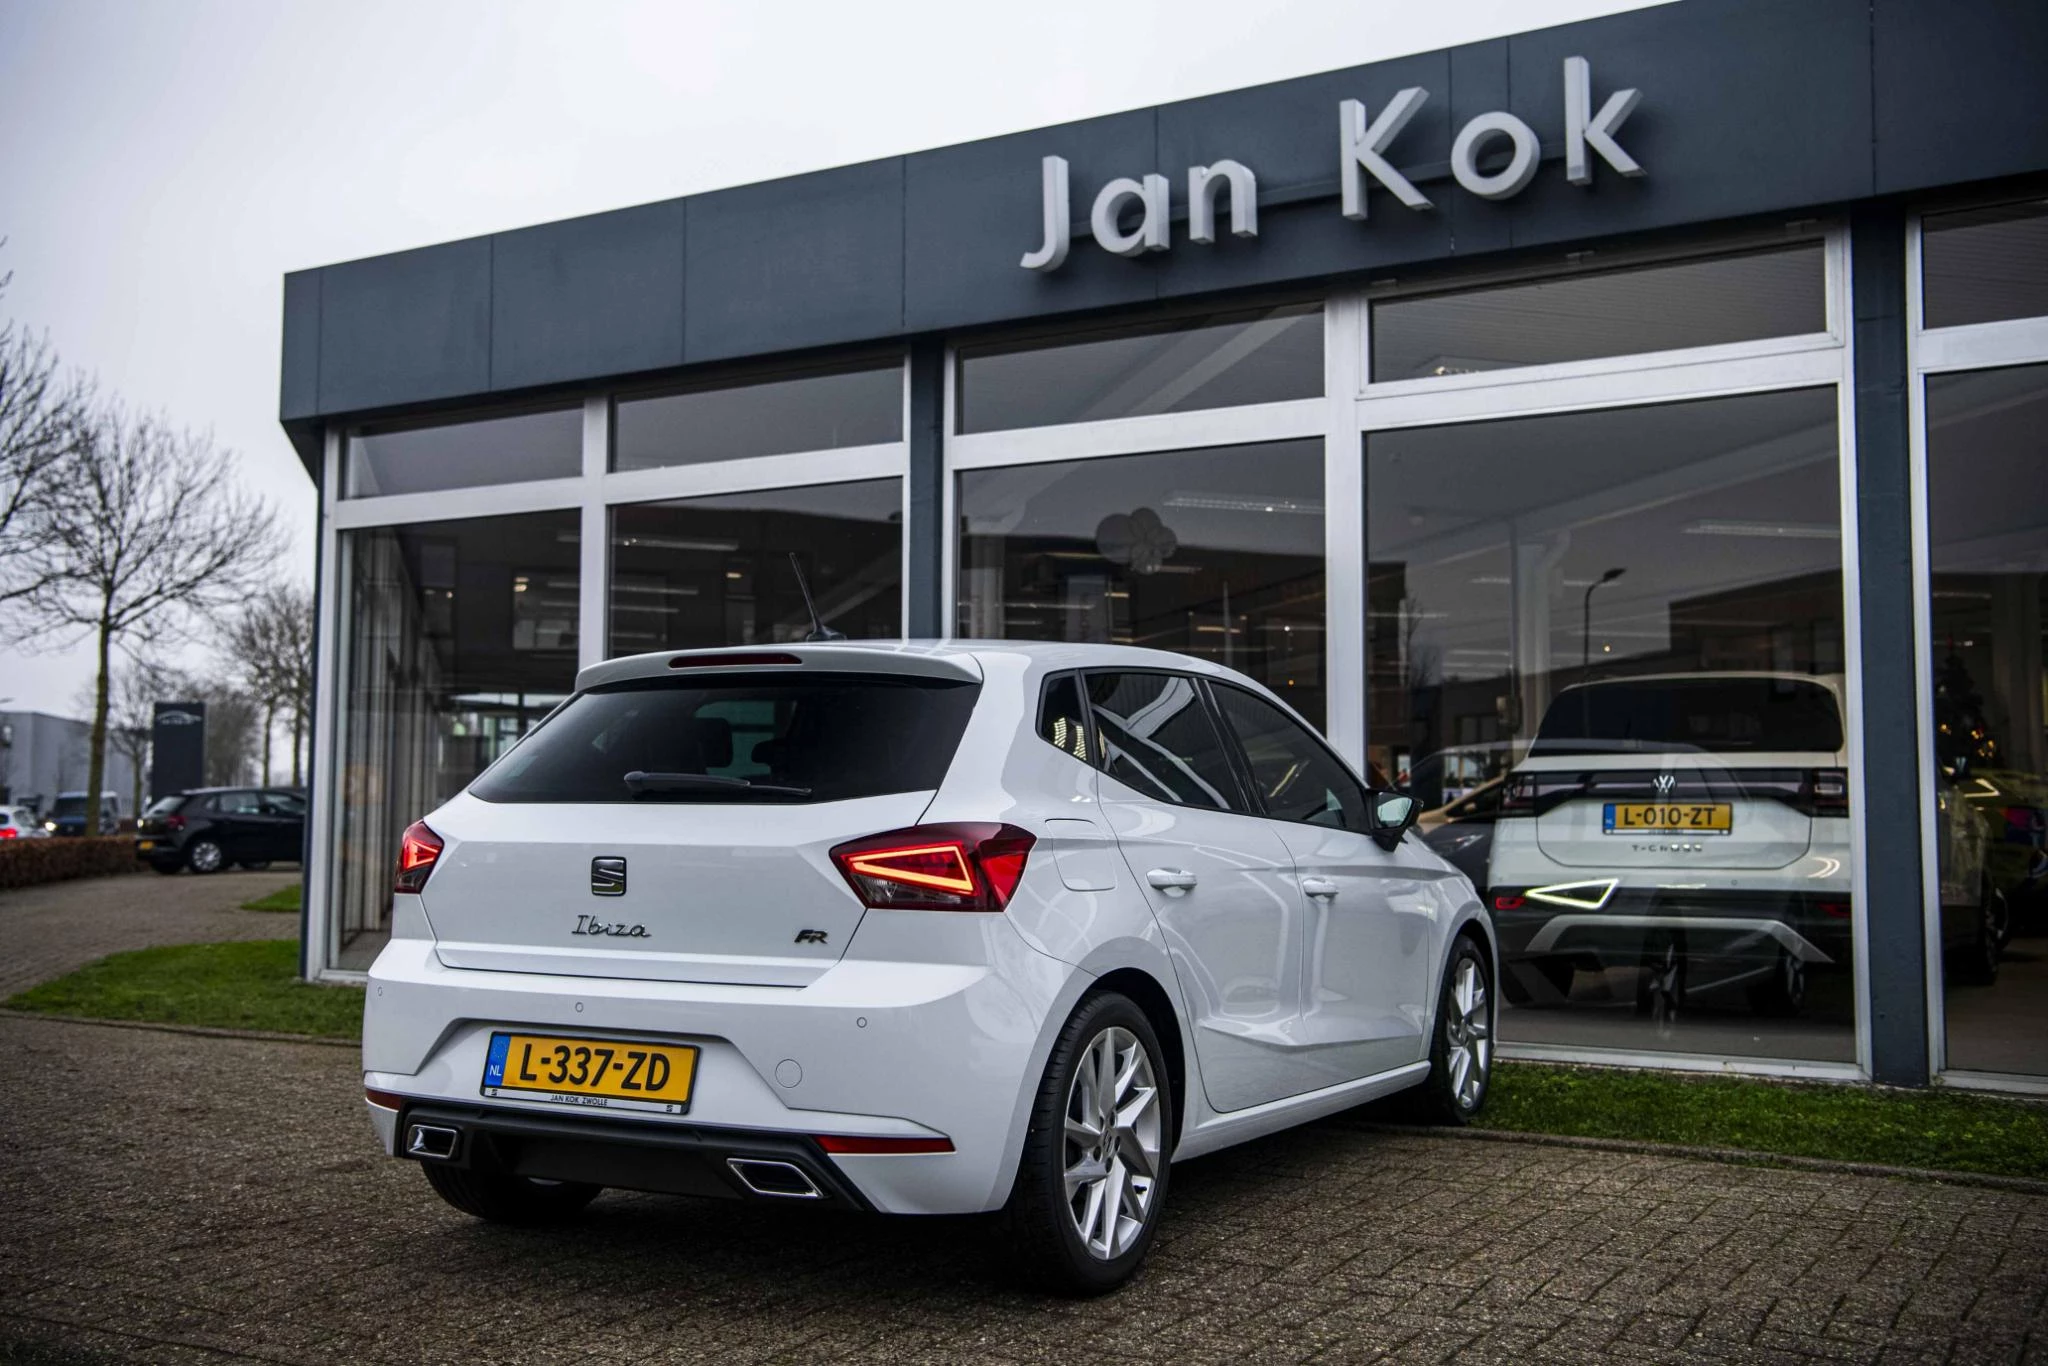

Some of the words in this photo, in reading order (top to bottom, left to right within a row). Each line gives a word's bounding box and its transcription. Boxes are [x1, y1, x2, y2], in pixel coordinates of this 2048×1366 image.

[1020, 155, 1258, 273] Jan
[1338, 56, 1648, 222] Kok
[1623, 807, 1717, 826] L-010-ZT
[571, 914, 652, 938] Ibiza
[794, 929, 829, 944] FR
[489, 1065, 502, 1077] NL
[519, 1043, 671, 1092] L-337-ZD
[550, 1094, 564, 1102] JAN
